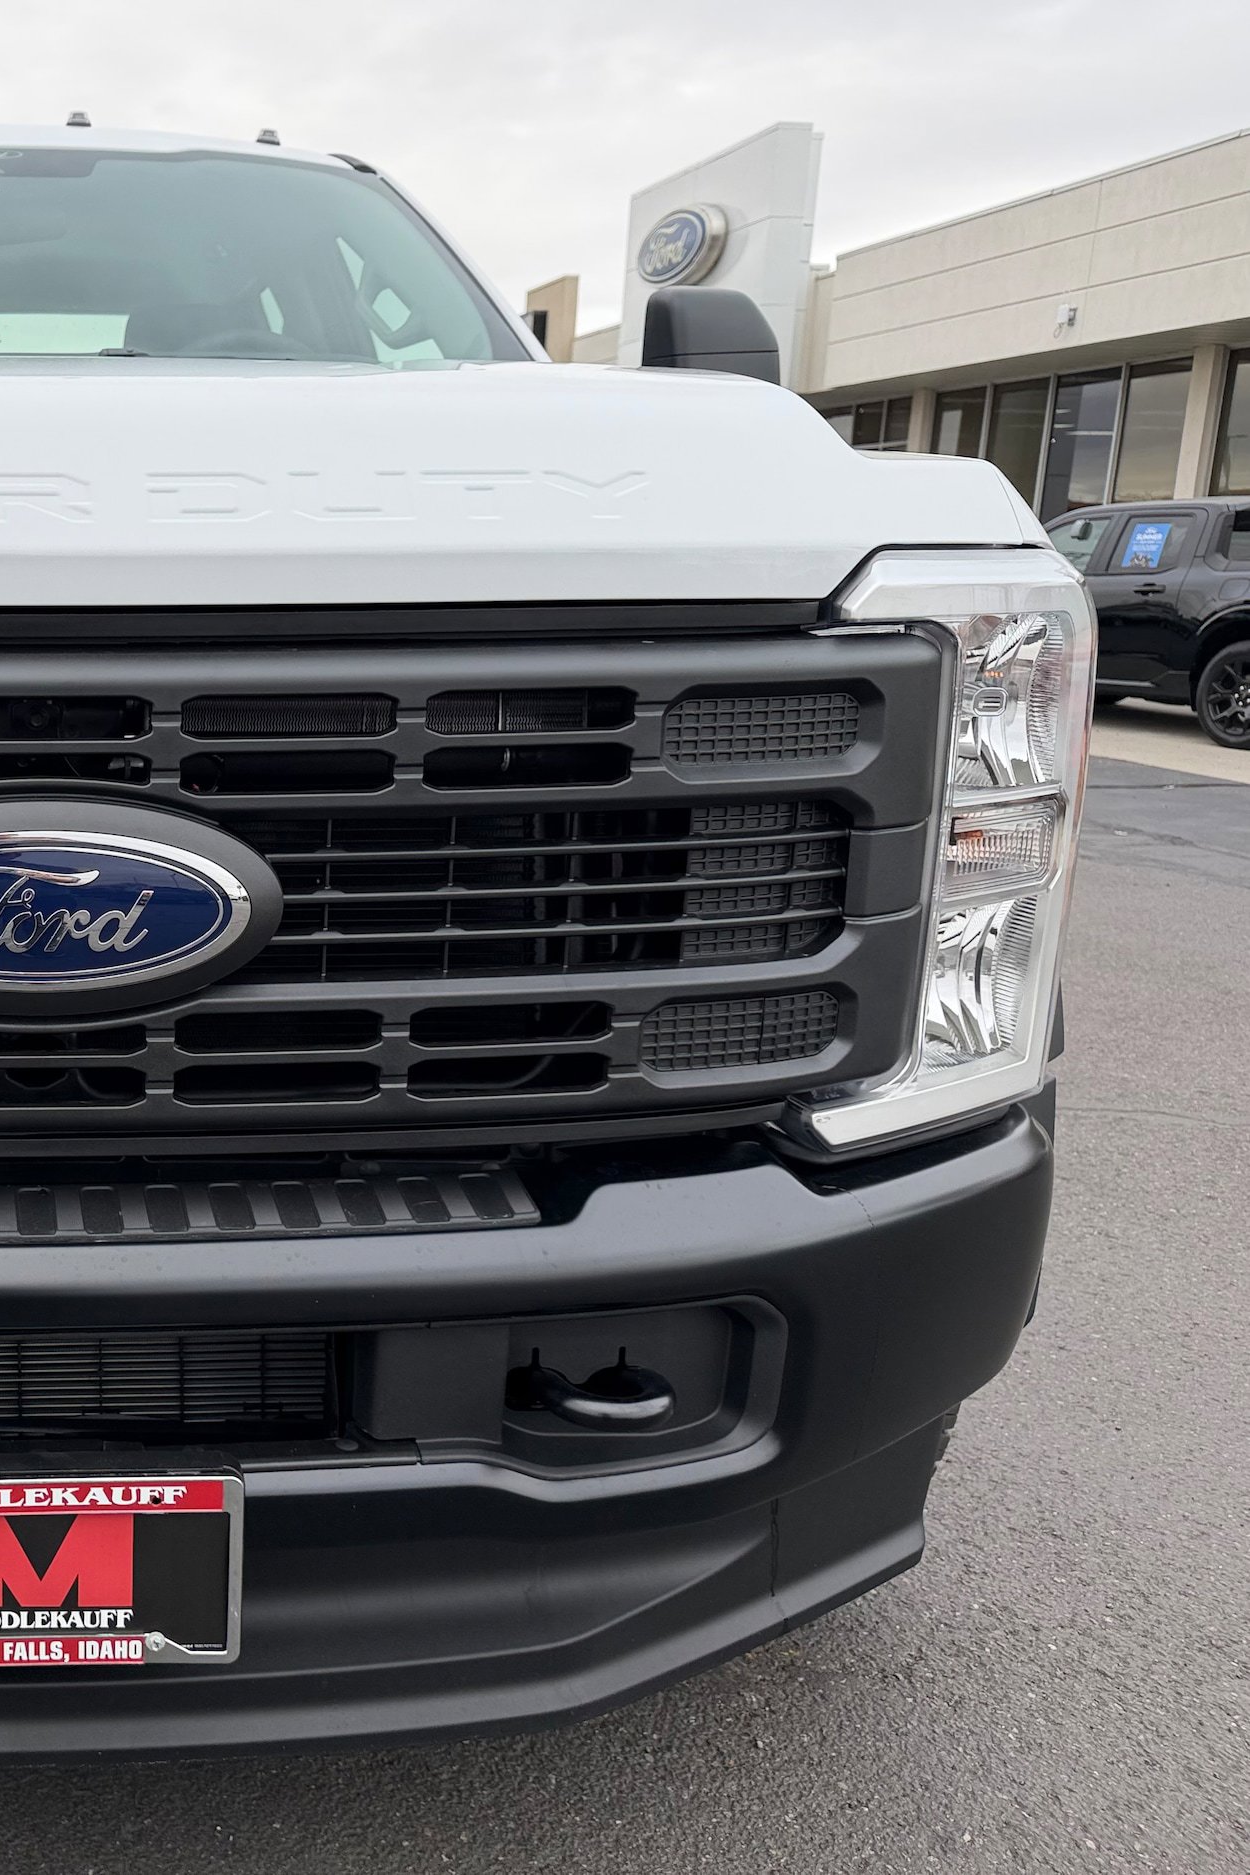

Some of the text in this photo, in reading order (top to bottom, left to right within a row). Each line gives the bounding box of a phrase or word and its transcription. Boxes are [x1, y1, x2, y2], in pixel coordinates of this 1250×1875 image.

[645, 222, 691, 274] Ford
[143, 470, 651, 523] DUTY
[3, 1640, 70, 1663] FALLS,
[78, 1639, 143, 1660] IDAHO
